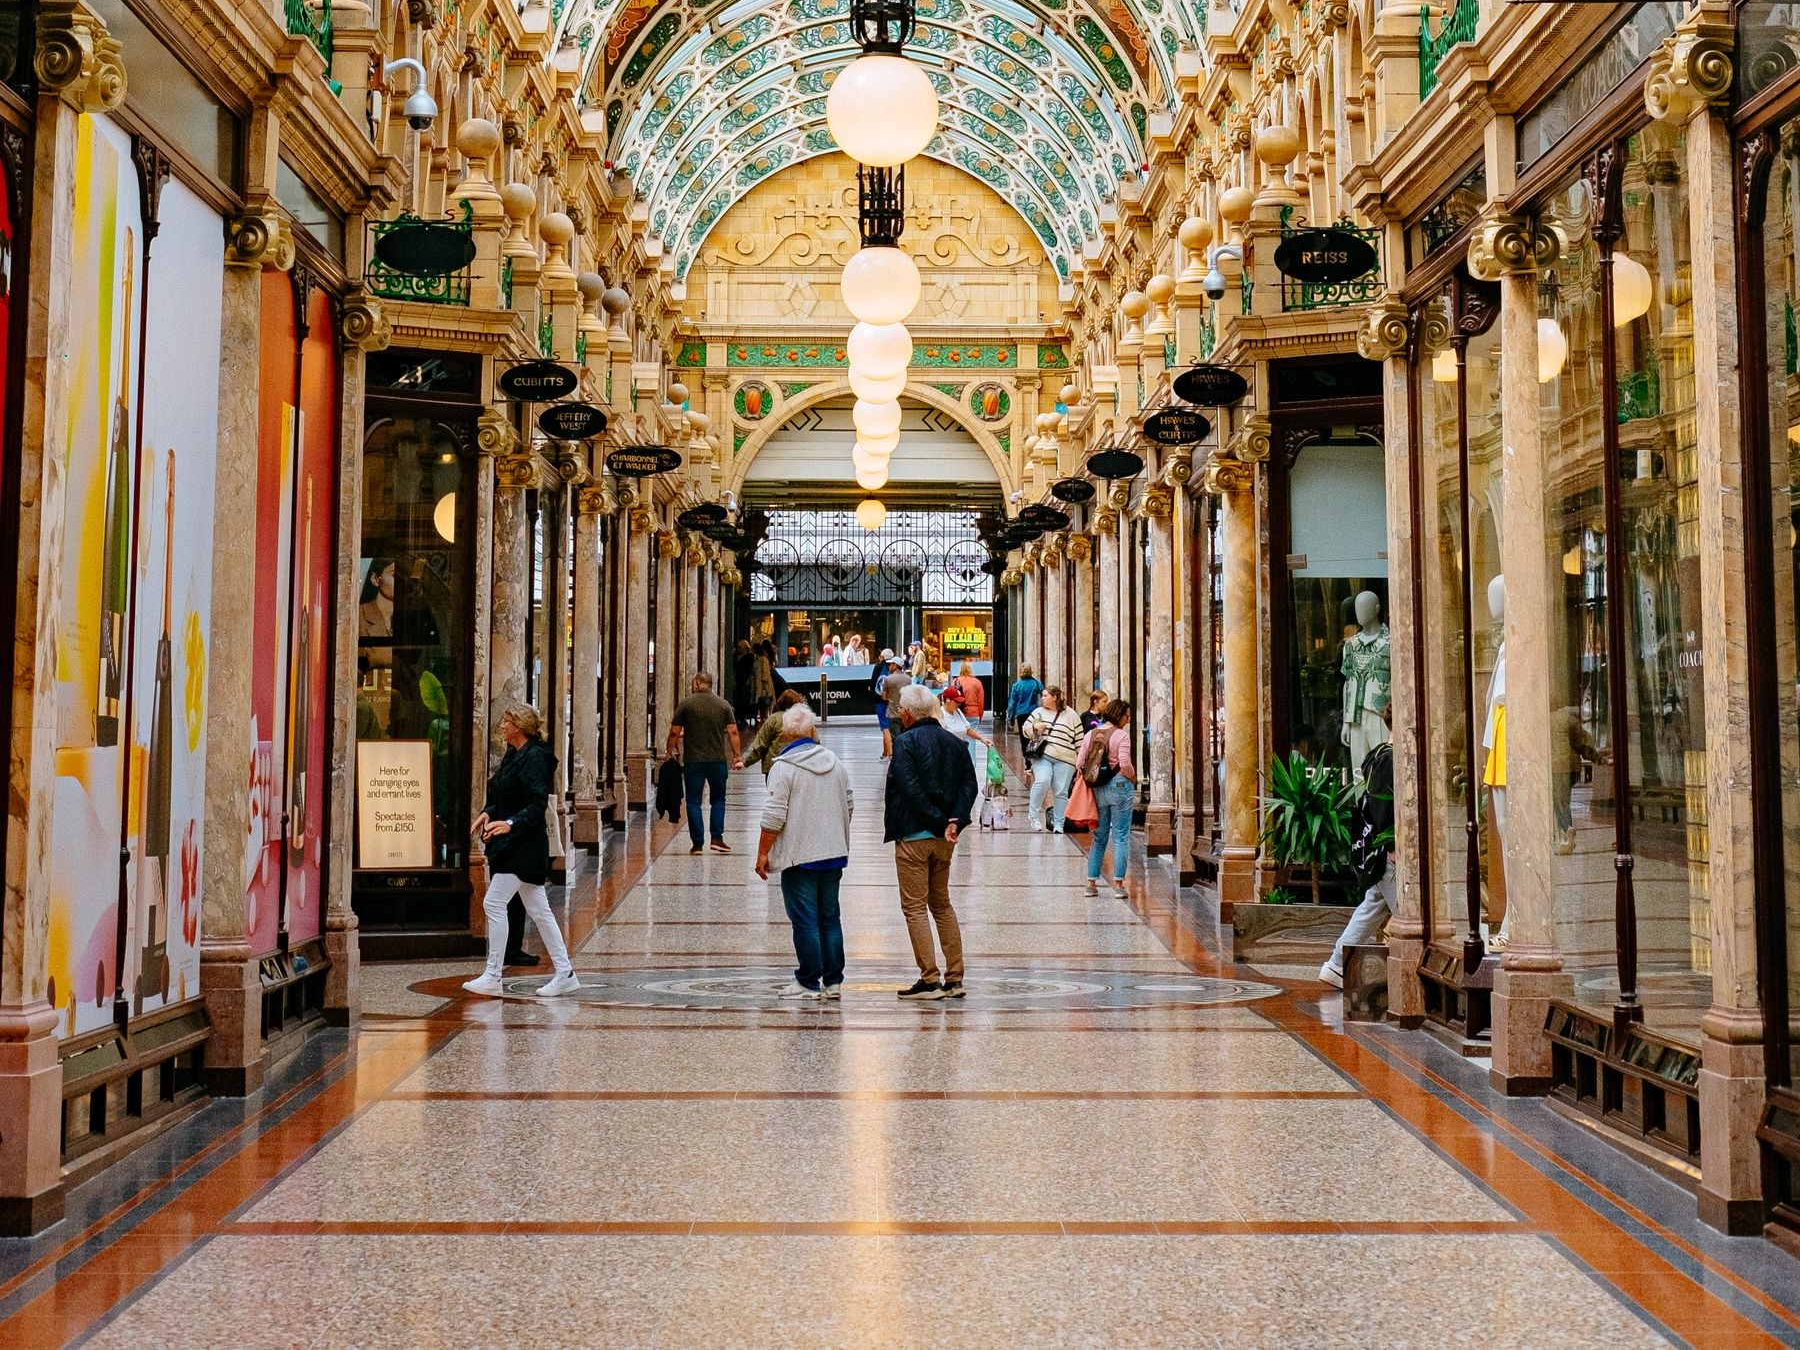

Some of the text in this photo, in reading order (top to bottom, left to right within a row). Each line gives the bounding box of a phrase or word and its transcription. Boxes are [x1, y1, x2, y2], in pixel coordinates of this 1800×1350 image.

[1302, 251, 1348, 264] REISS
[513, 377, 564, 387] CUBITTS
[1191, 374, 1230, 384] HAWES
[1189, 391, 1231, 400] CURTIS
[554, 412, 593, 422] JEFFERY
[1159, 416, 1196, 425] HAWES
[560, 422, 587, 431] WEST
[1158, 431, 1196, 440] CURTIS
[610, 453, 660, 464] CHARBONNEL
[613, 462, 657, 471] ET WALKER
[944, 633, 986, 641] GET £10 OFF
[379, 766, 410, 776] Here for
[369, 778, 420, 789] changing eyes
[367, 789, 421, 798] and errant lives
[375, 811, 416, 822] Spectacles
[375, 823, 415, 832] from £150.
[387, 877, 421, 887] CUBITTS
